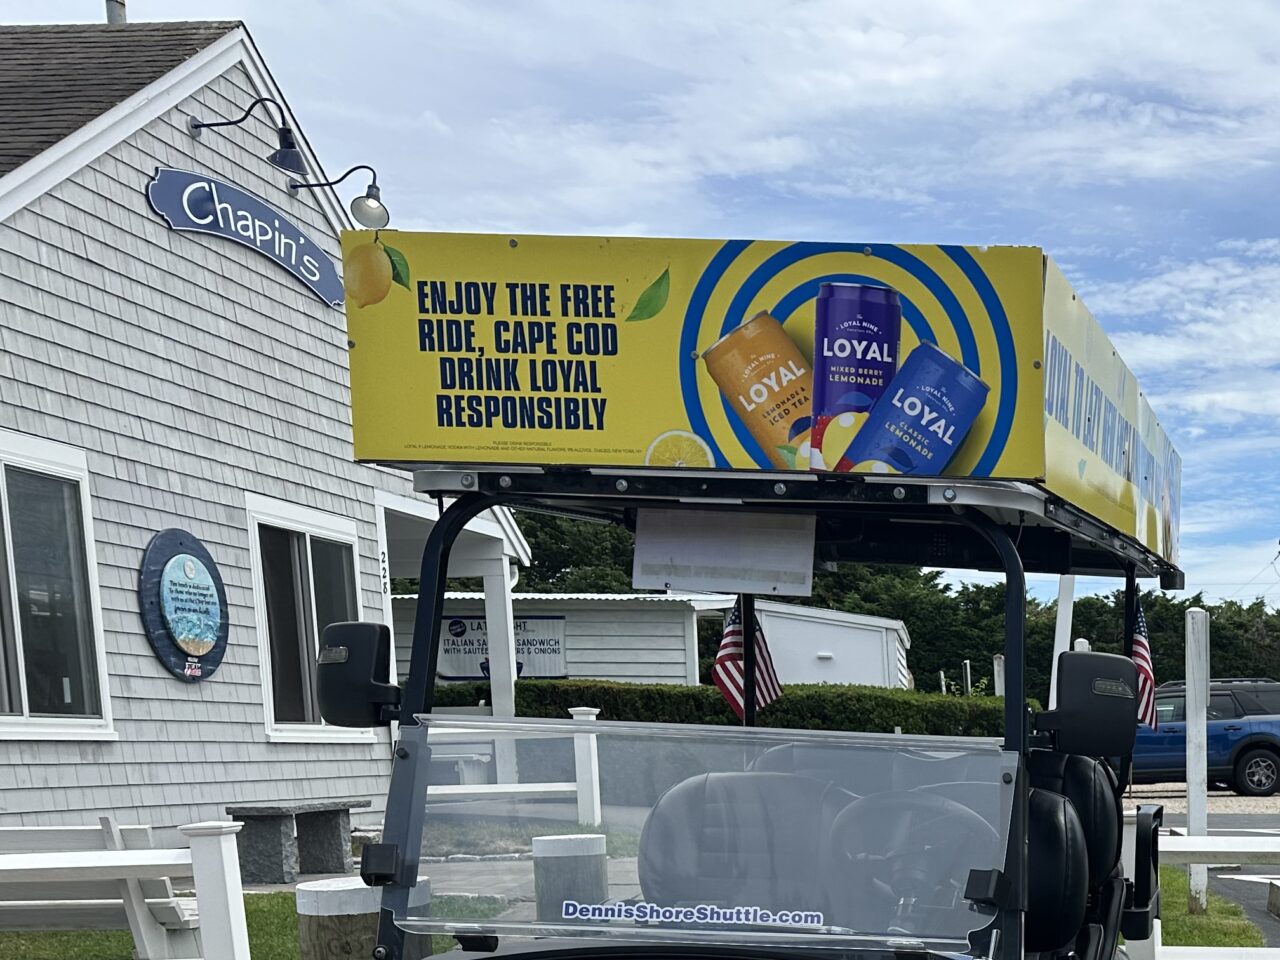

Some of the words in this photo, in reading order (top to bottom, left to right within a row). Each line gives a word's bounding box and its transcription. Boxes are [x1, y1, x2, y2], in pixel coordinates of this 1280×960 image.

[182, 180, 320, 283] Chapin's
[417, 281, 498, 317] ENJOY
[505, 283, 551, 318] THE
[560, 284, 617, 319] FREE
[418, 319, 487, 357] RIDE,
[494, 321, 557, 356] CAPE
[567, 322, 618, 357] COD
[839, 321, 861, 329] LOYAL
[862, 321, 879, 332] NINE
[823, 338, 893, 363] LOYAL
[440, 357, 520, 393] DRINK
[529, 359, 602, 394] LOYAL
[829, 374, 884, 386] LEMONADE
[830, 366, 855, 375] MIXED
[858, 367, 883, 376] BERRY
[738, 359, 806, 412] LOYAL
[921, 385, 942, 399] LOYAL
[942, 397, 955, 412] NINE
[436, 394, 608, 431] RESPONSIBLY
[762, 390, 800, 418] LEMONADE
[769, 408, 791, 426] ICED
[791, 396, 810, 410] TEA
[892, 388, 957, 446] LOYAL
[884, 421, 934, 460] LEMONADE
[899, 421, 929, 445] CLASSIC
[470, 622, 488, 631] LAT
[443, 639, 474, 647] ITALIAN
[516, 639, 560, 647] SANDWICH
[562, 901, 822, 925] DennisShoreShuttle.com
